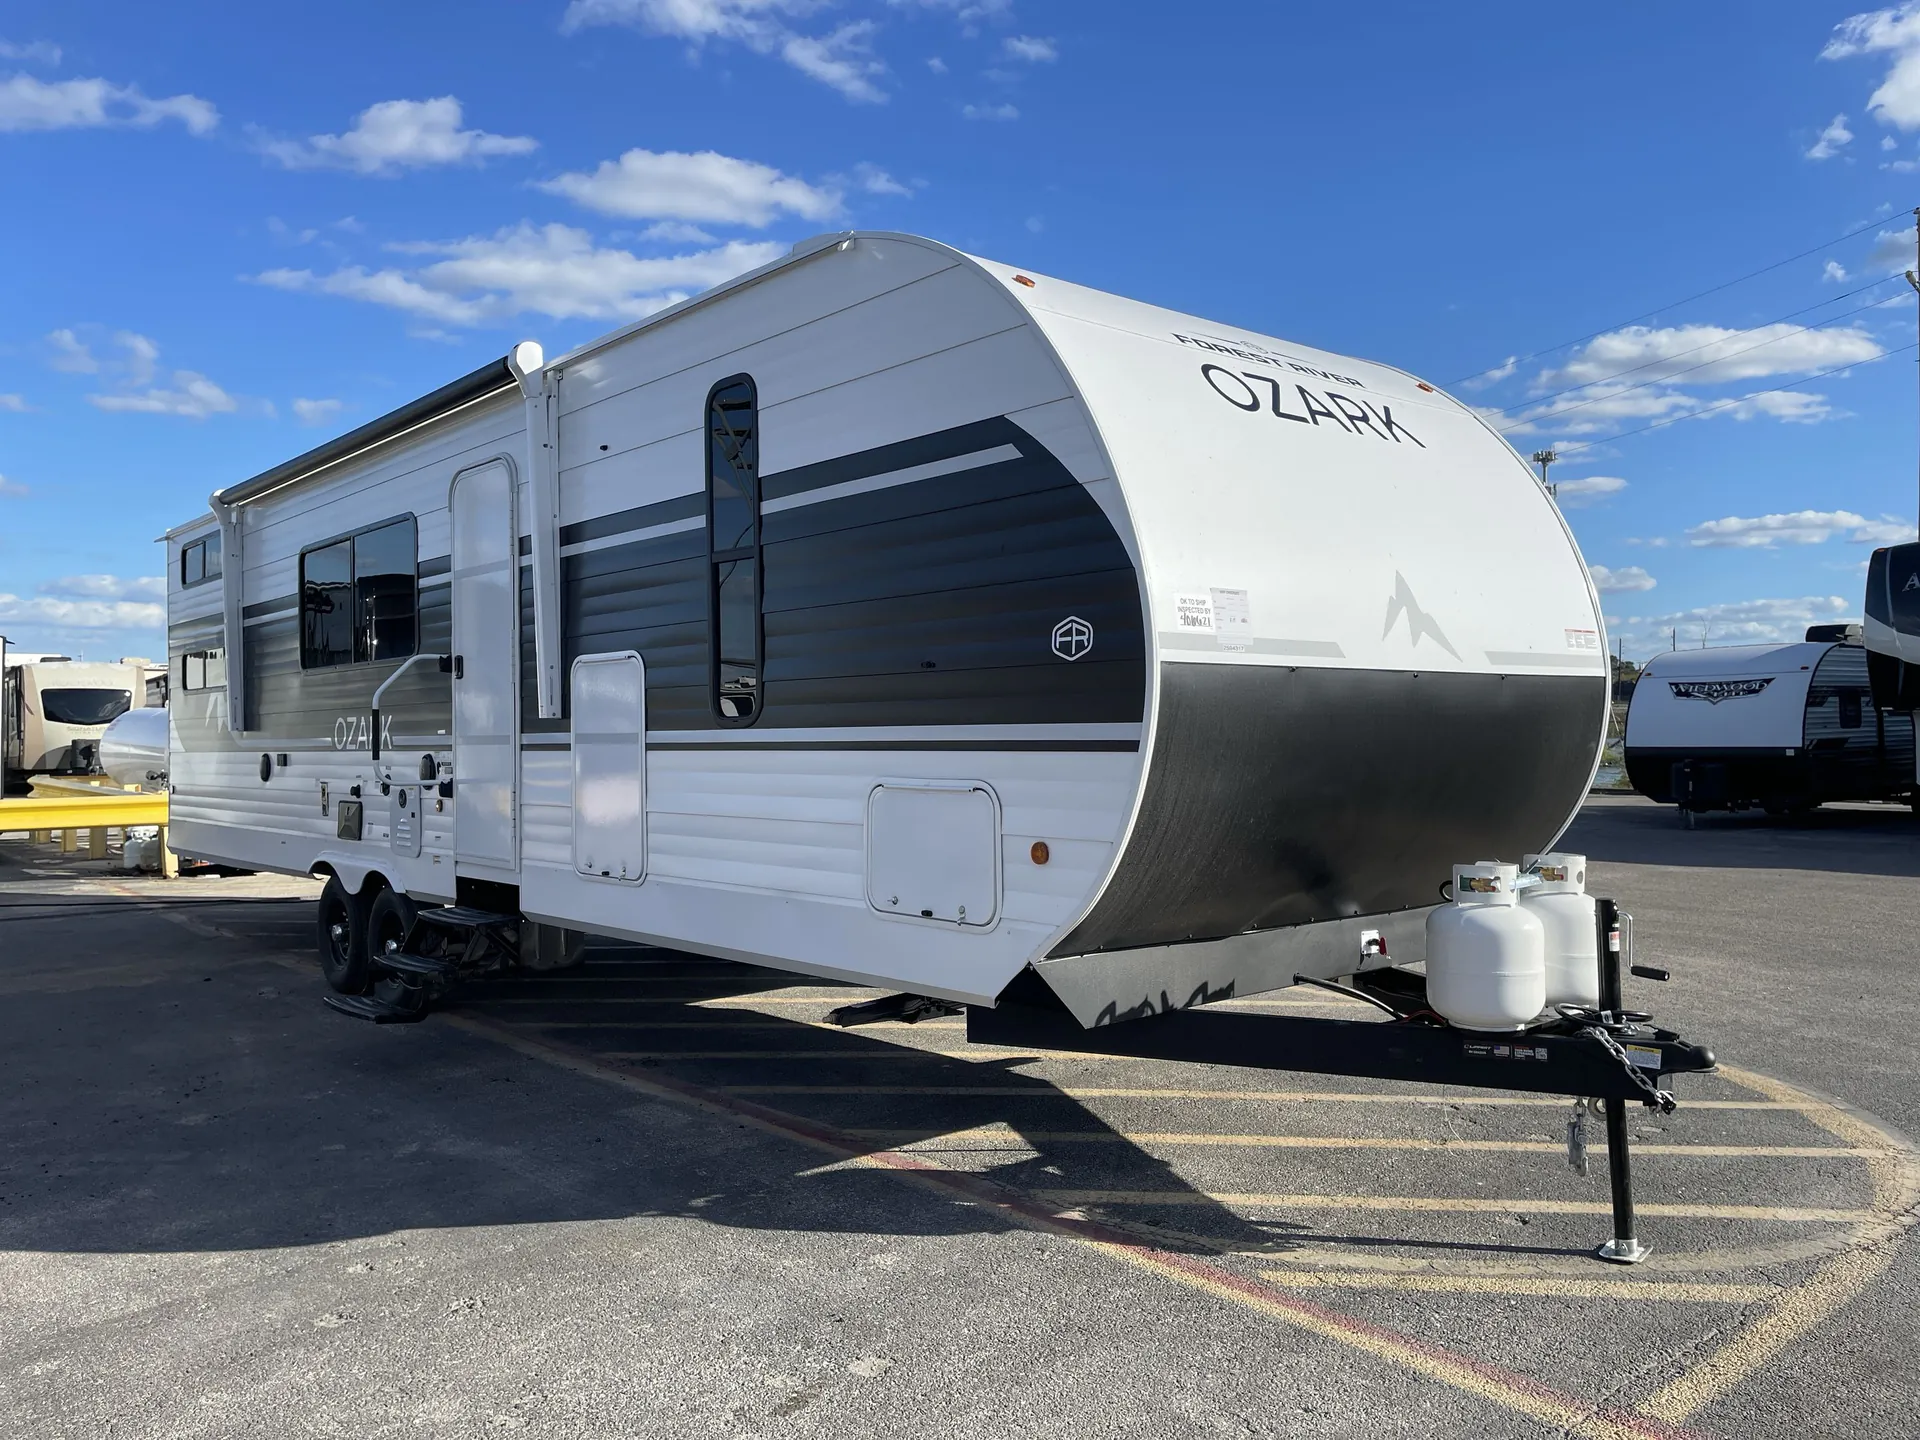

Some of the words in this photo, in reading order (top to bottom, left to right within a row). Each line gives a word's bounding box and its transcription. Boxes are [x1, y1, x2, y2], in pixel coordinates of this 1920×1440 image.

[1170, 332, 1283, 368] FOREST
[1287, 362, 1366, 388] RIVER
[1200, 363, 1427, 449] OZARK
[1188, 598, 1195, 606] TO
[1671, 680, 1768, 694] WILDWOOD
[334, 715, 393, 750] OZAK
